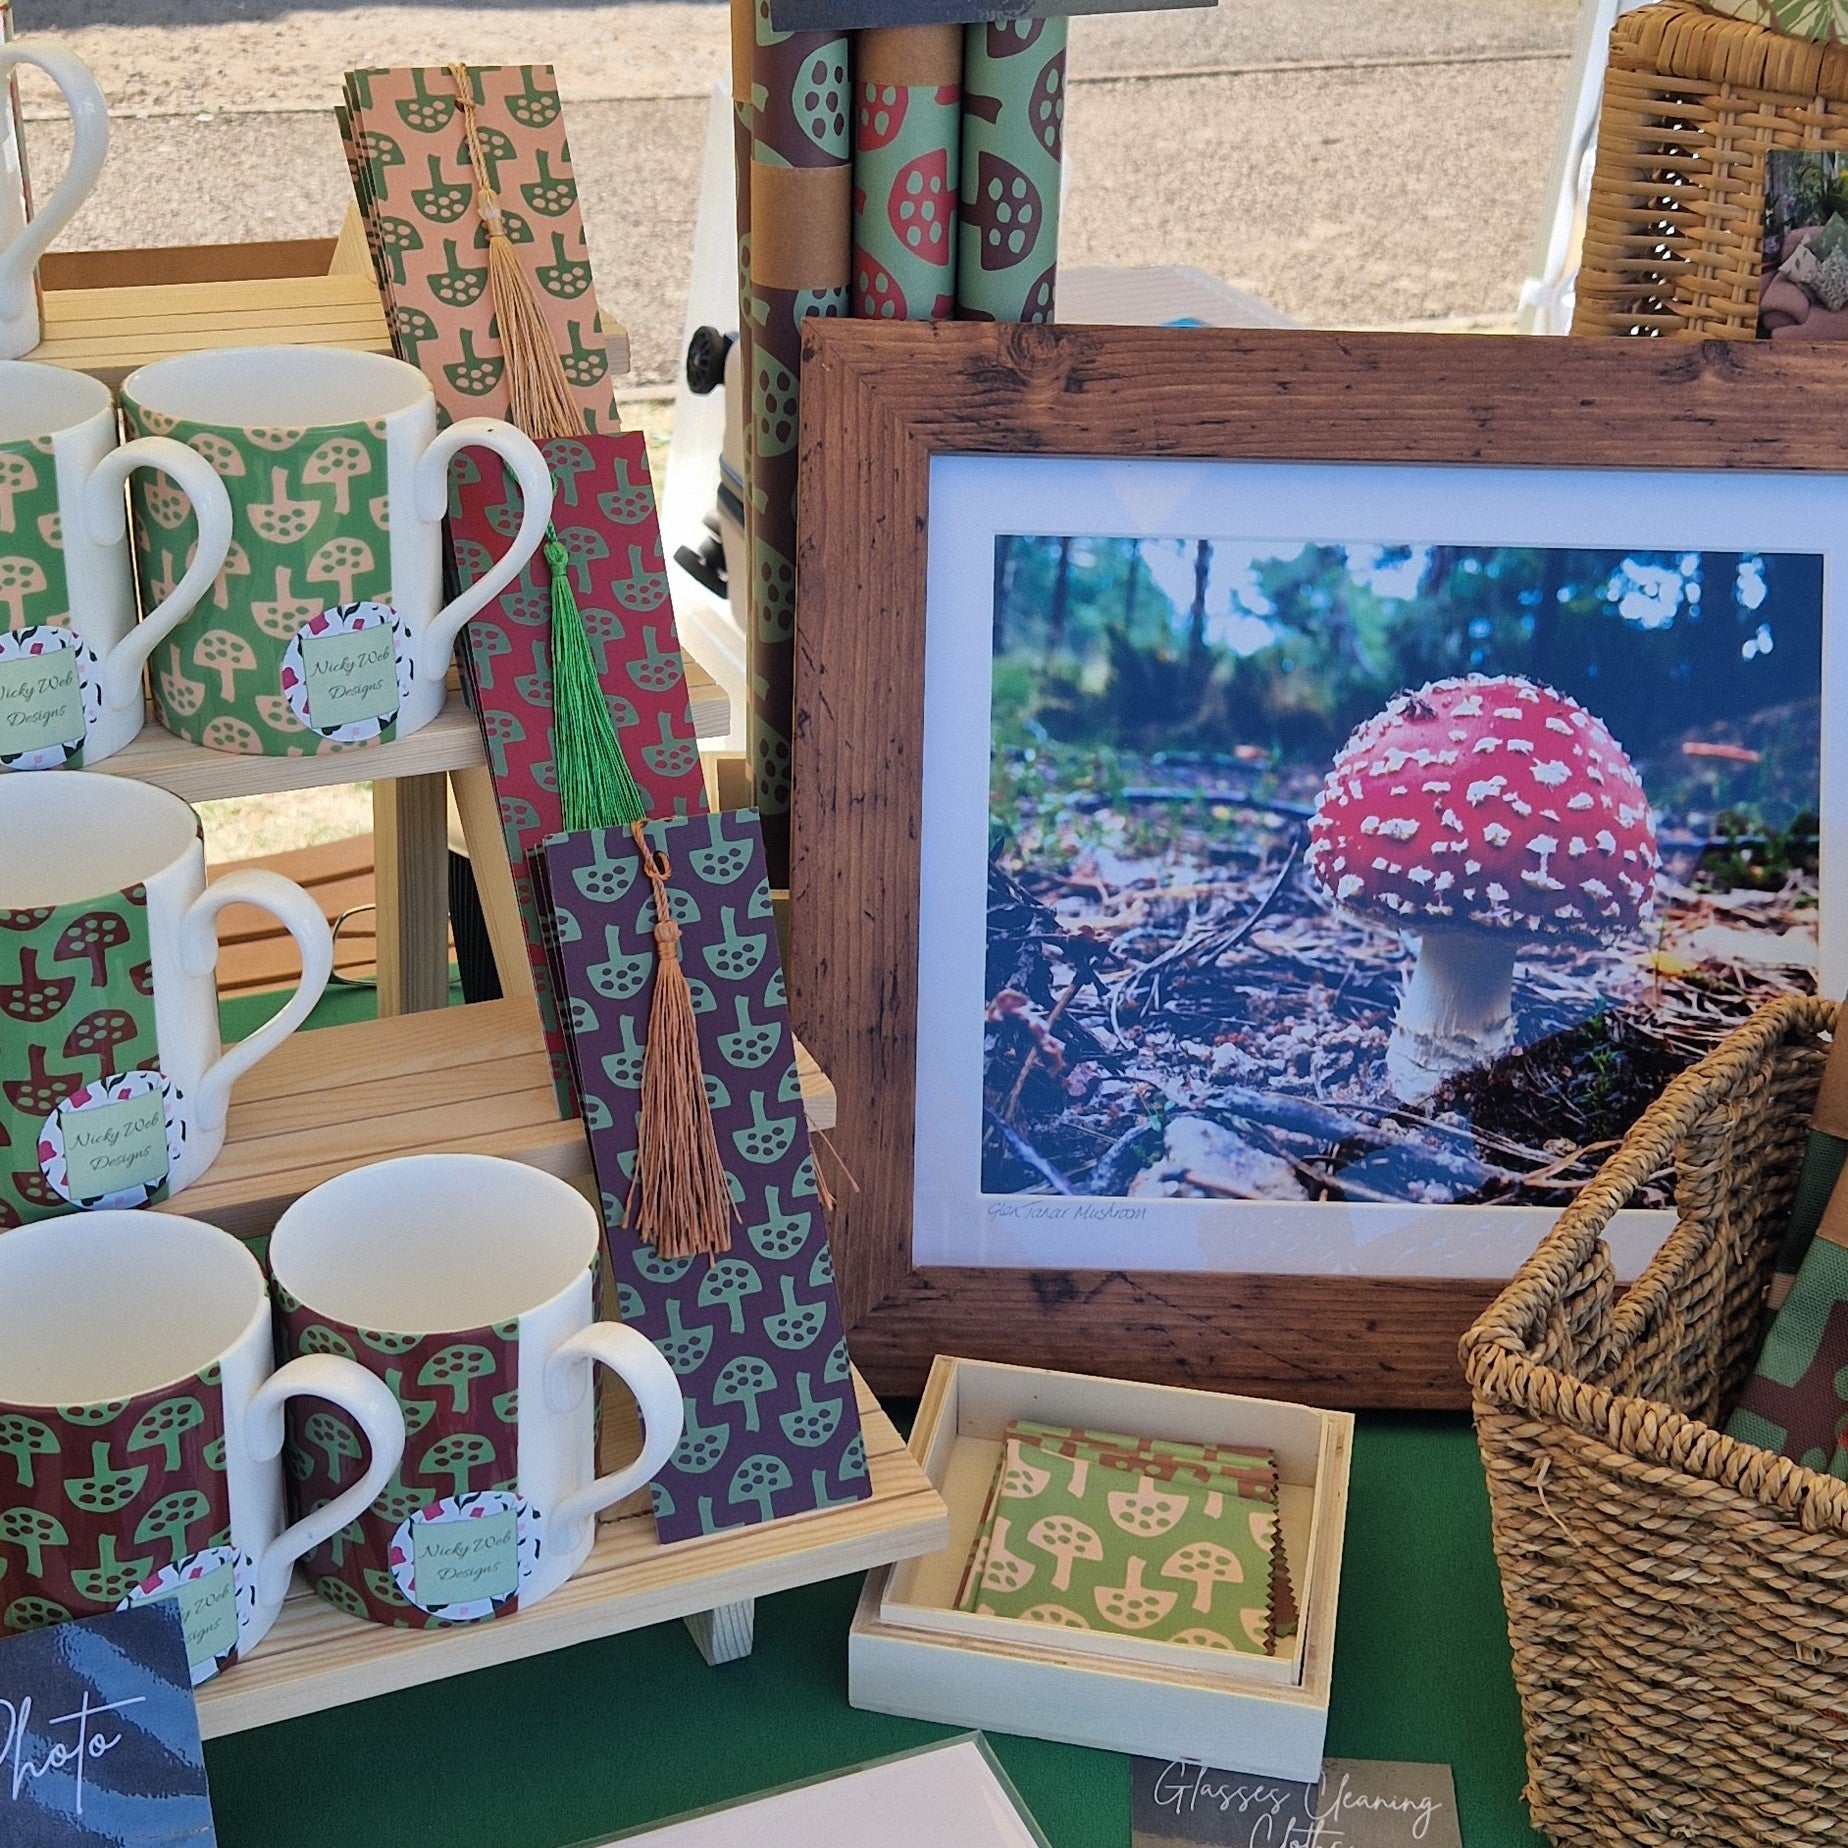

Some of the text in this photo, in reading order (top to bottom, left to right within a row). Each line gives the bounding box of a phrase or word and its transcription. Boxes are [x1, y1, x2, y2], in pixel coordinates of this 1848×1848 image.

[310, 646, 390, 677] Nicky Web
[38, 670, 73, 694] Web
[327, 679, 383, 700] Designs
[6, 705, 67, 727] Designs
[69, 1111, 160, 1150] Nicky Web
[89, 1145, 152, 1171] Designs
[419, 1530, 511, 1559] Nicky Web
[436, 1561, 501, 1581] Designs
[194, 1582, 230, 1615] Web
[187, 1617, 222, 1645] signs
[1154, 1761, 1443, 1840] Glasses Cleaning
